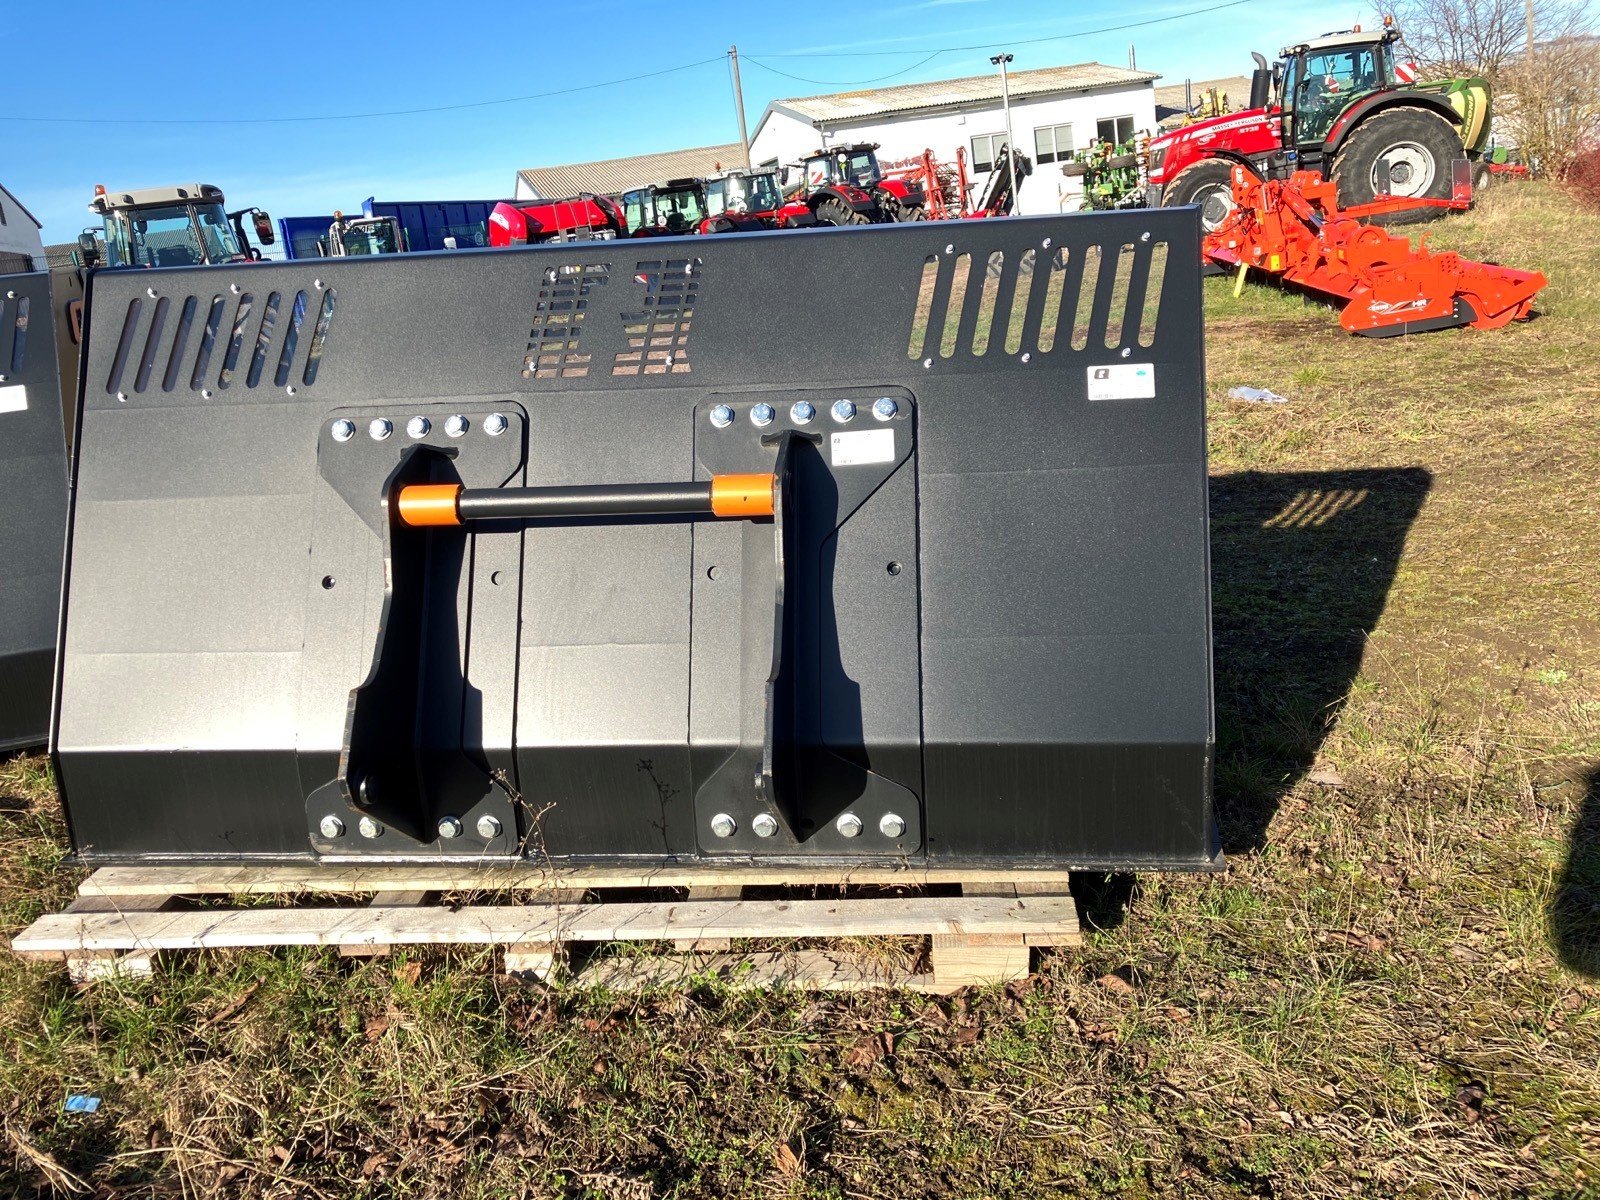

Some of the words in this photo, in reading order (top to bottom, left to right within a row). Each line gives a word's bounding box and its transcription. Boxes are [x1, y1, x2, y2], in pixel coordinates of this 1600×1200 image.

[1212, 123, 1233, 131] MASSEY
[1234, 117, 1263, 126] FERGUSON
[1465, 94, 1474, 134] KRONE
